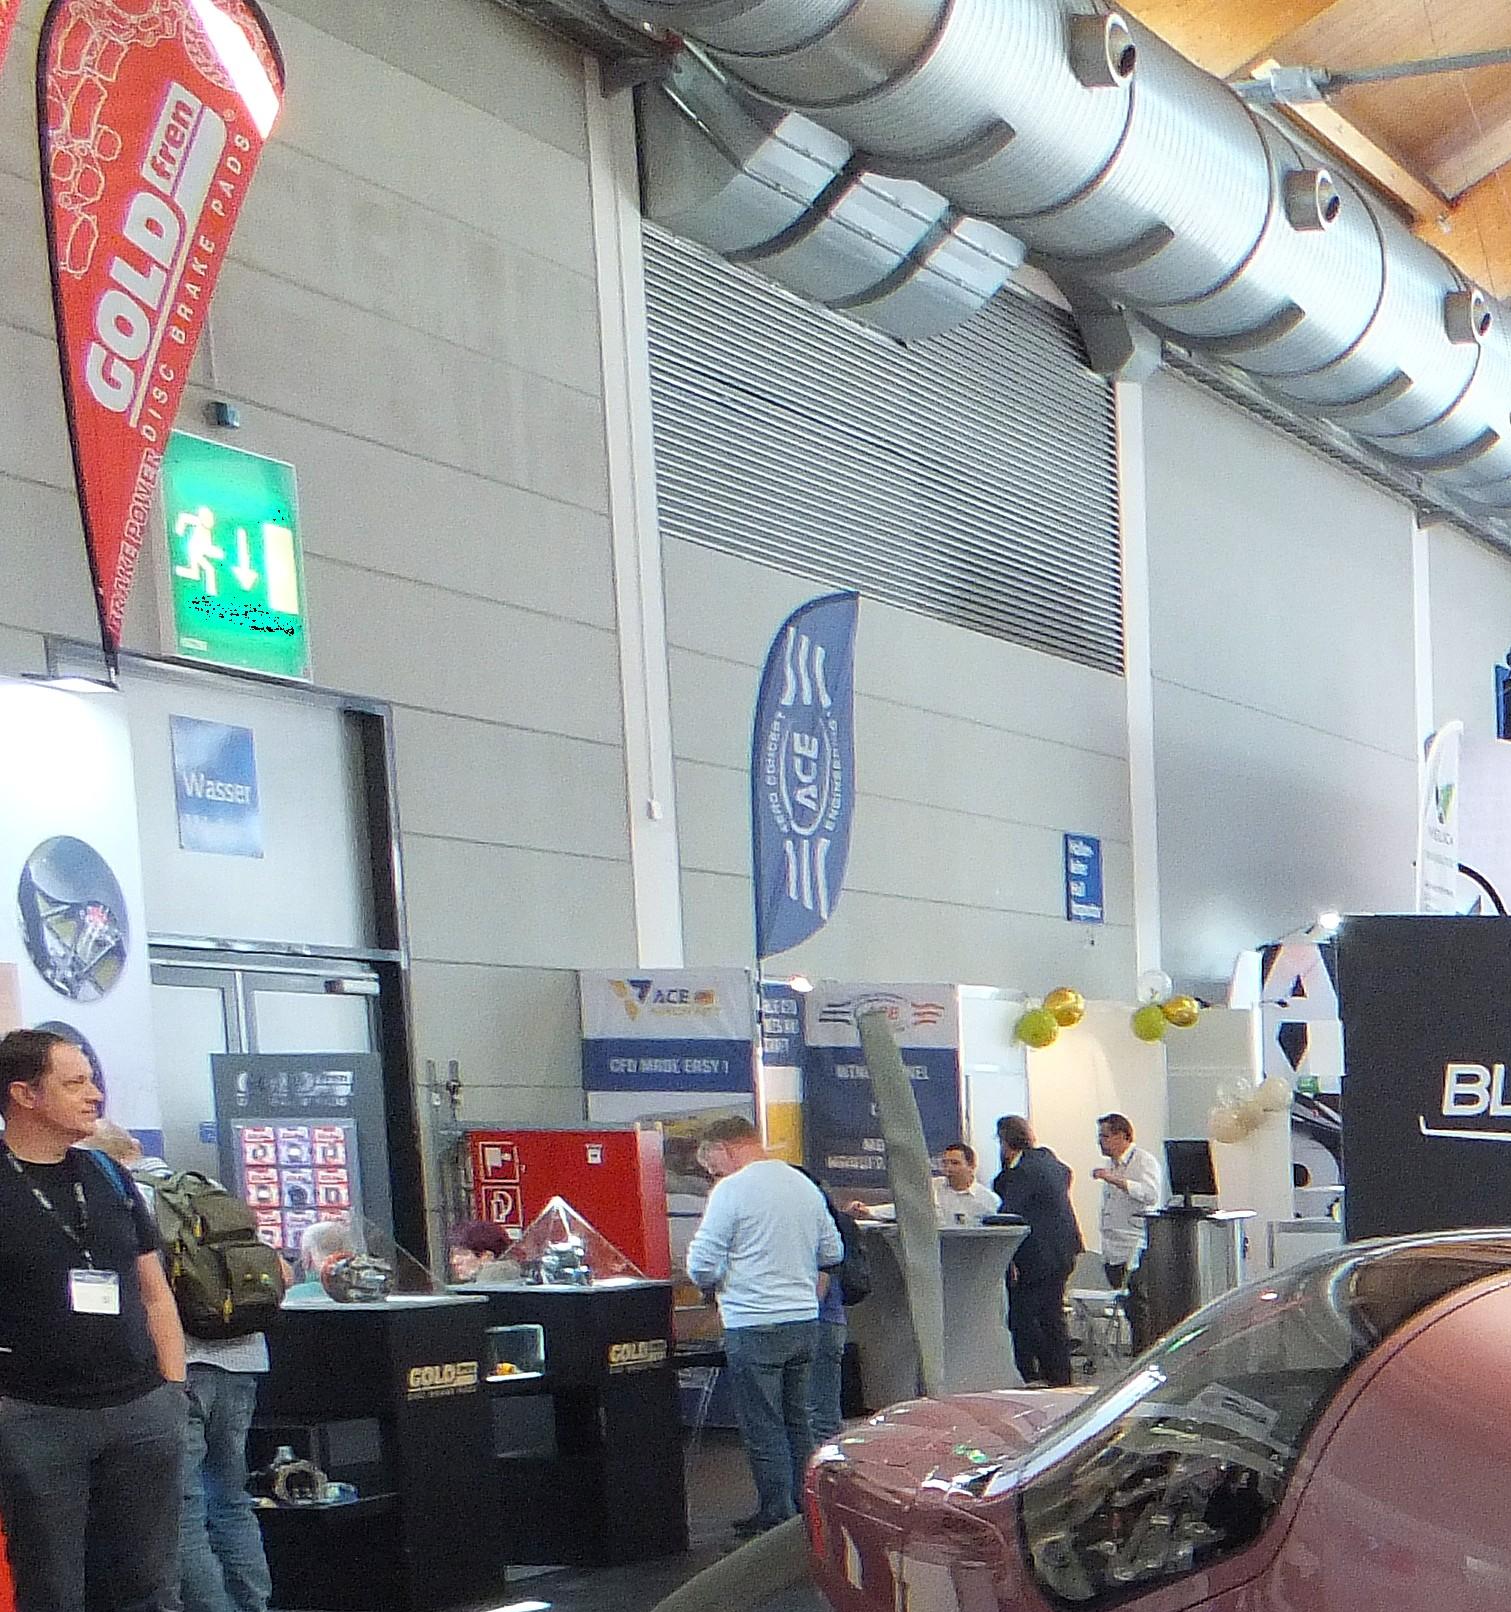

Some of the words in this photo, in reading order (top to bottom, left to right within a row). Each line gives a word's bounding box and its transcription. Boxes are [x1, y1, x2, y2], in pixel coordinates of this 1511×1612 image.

[150, 99, 194, 181] fren
[86, 191, 182, 414] GOLD
[141, 364, 176, 442] DISC
[170, 235, 217, 345] BRAKE
[210, 134, 251, 217] PADS
[183, 770, 253, 805] Wasser
[793, 731, 819, 811] ACE
[409, 1364, 456, 1388] GOLD
